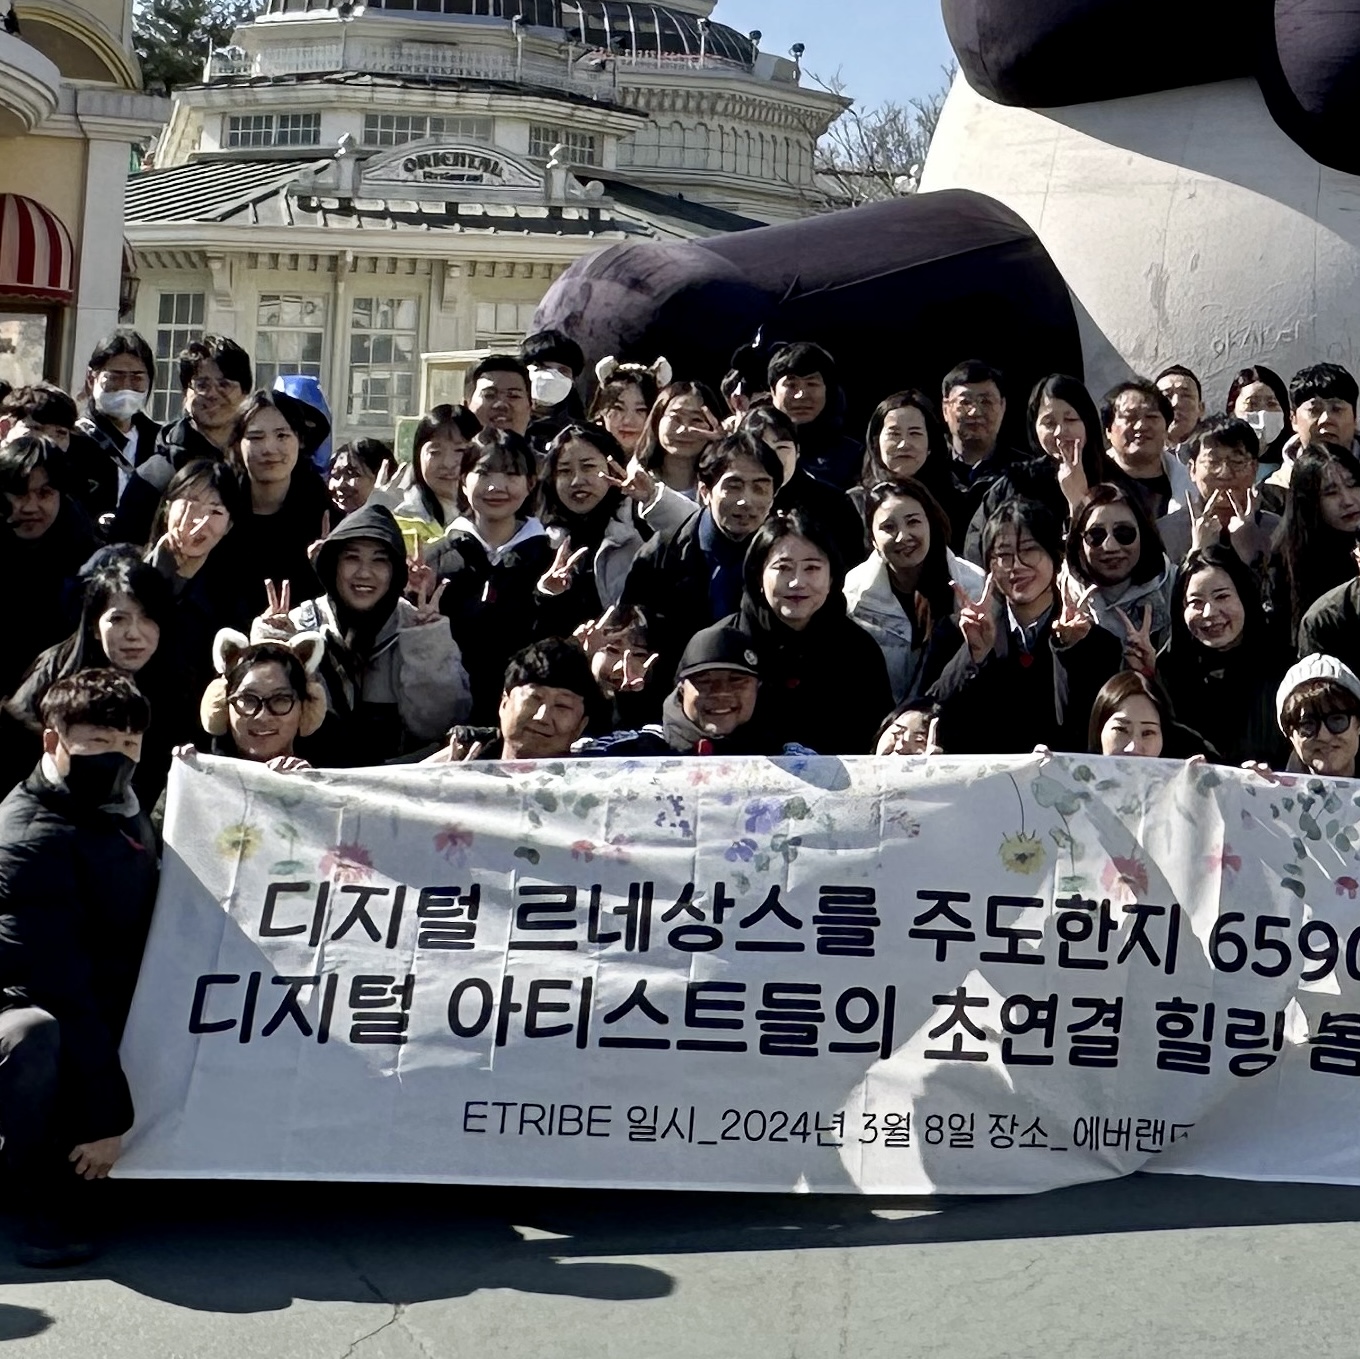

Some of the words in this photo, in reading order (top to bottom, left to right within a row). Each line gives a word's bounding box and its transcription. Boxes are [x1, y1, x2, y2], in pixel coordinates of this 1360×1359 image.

[258, 881, 481, 950] 디지털
[508, 881, 882, 957] 르네상스를
[908, 890, 1182, 975] 주도한지
[188, 971, 416, 1045] 디지털
[447, 975, 897, 1060] 아티스트들의
[923, 986, 1124, 1068] 초연결
[1155, 996, 1286, 1077] 힐링
[463, 1101, 612, 1138] ETRIBE
[627, 1105, 846, 1148] 일시_2024년
[858, 1111, 911, 1149] 3월
[924, 1112, 975, 1149] 8일
